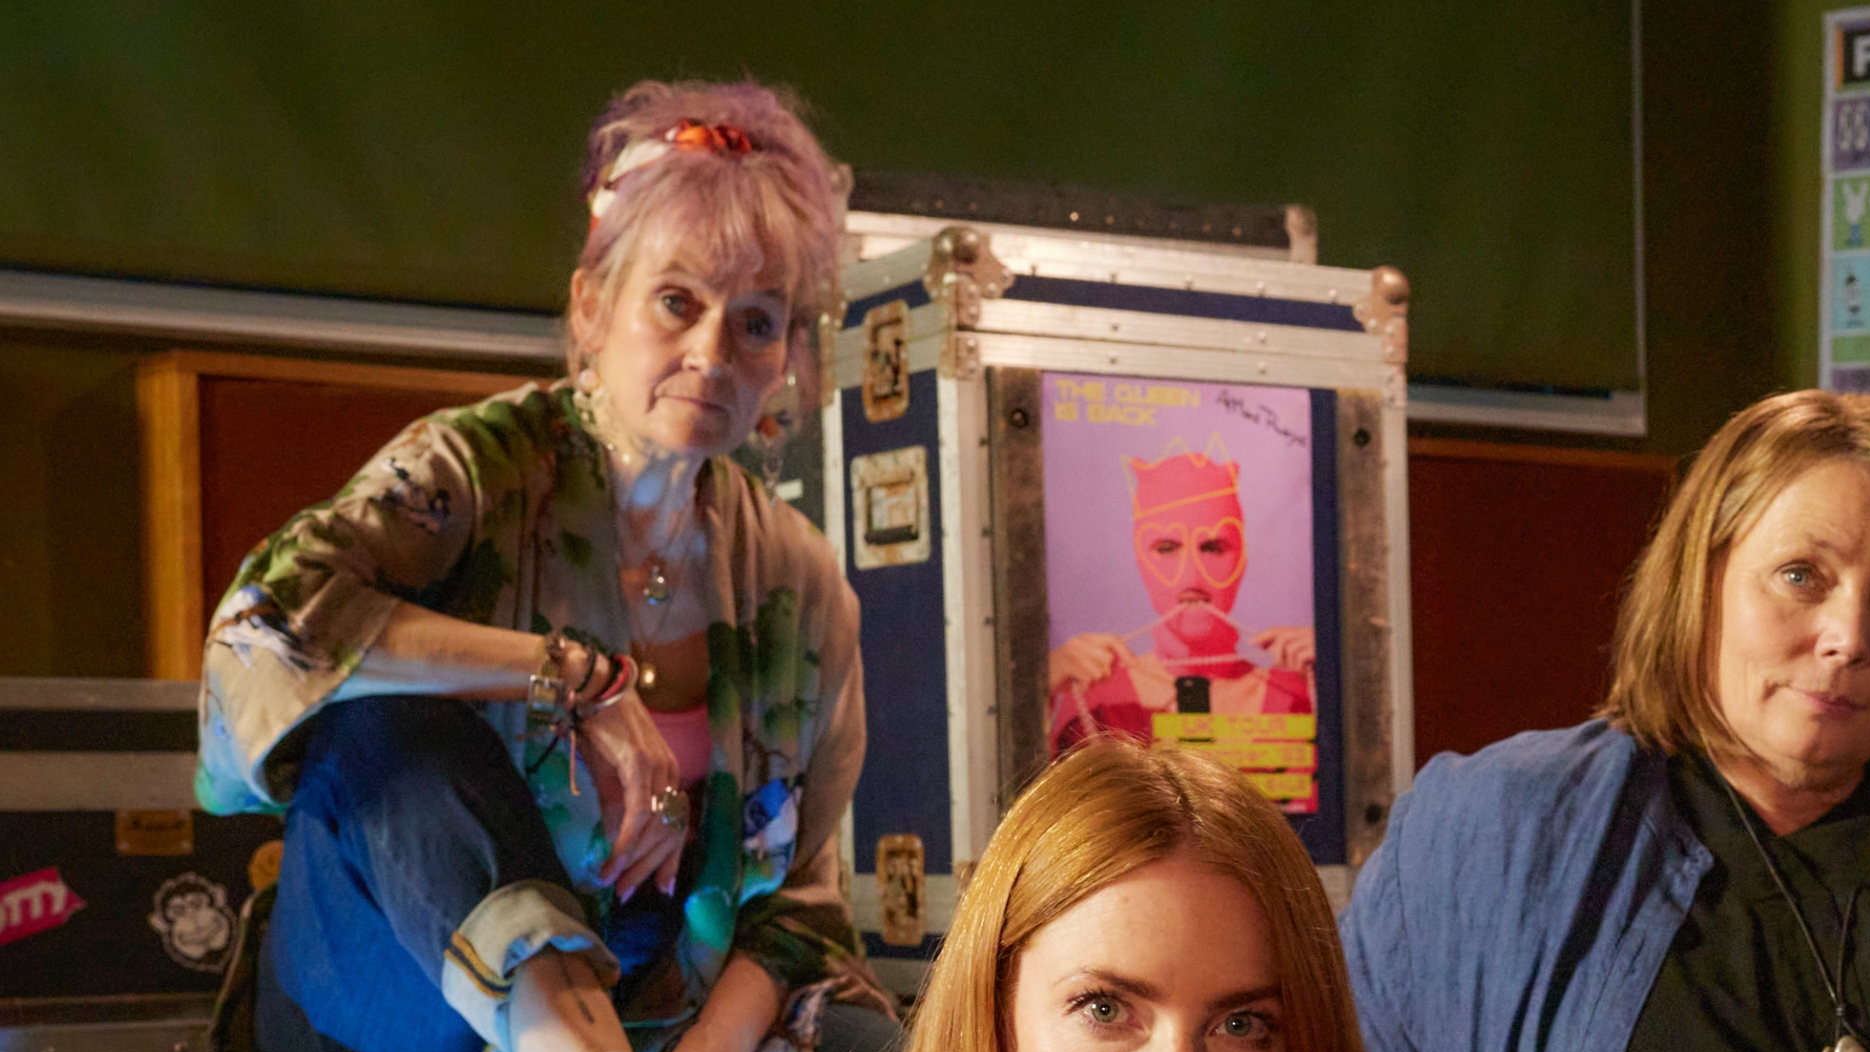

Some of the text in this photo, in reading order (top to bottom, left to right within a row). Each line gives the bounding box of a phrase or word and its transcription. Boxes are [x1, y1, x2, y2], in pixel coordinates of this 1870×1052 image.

[1055, 379, 1201, 408] THE QUEEN
[1086, 404, 1158, 426] BACK
